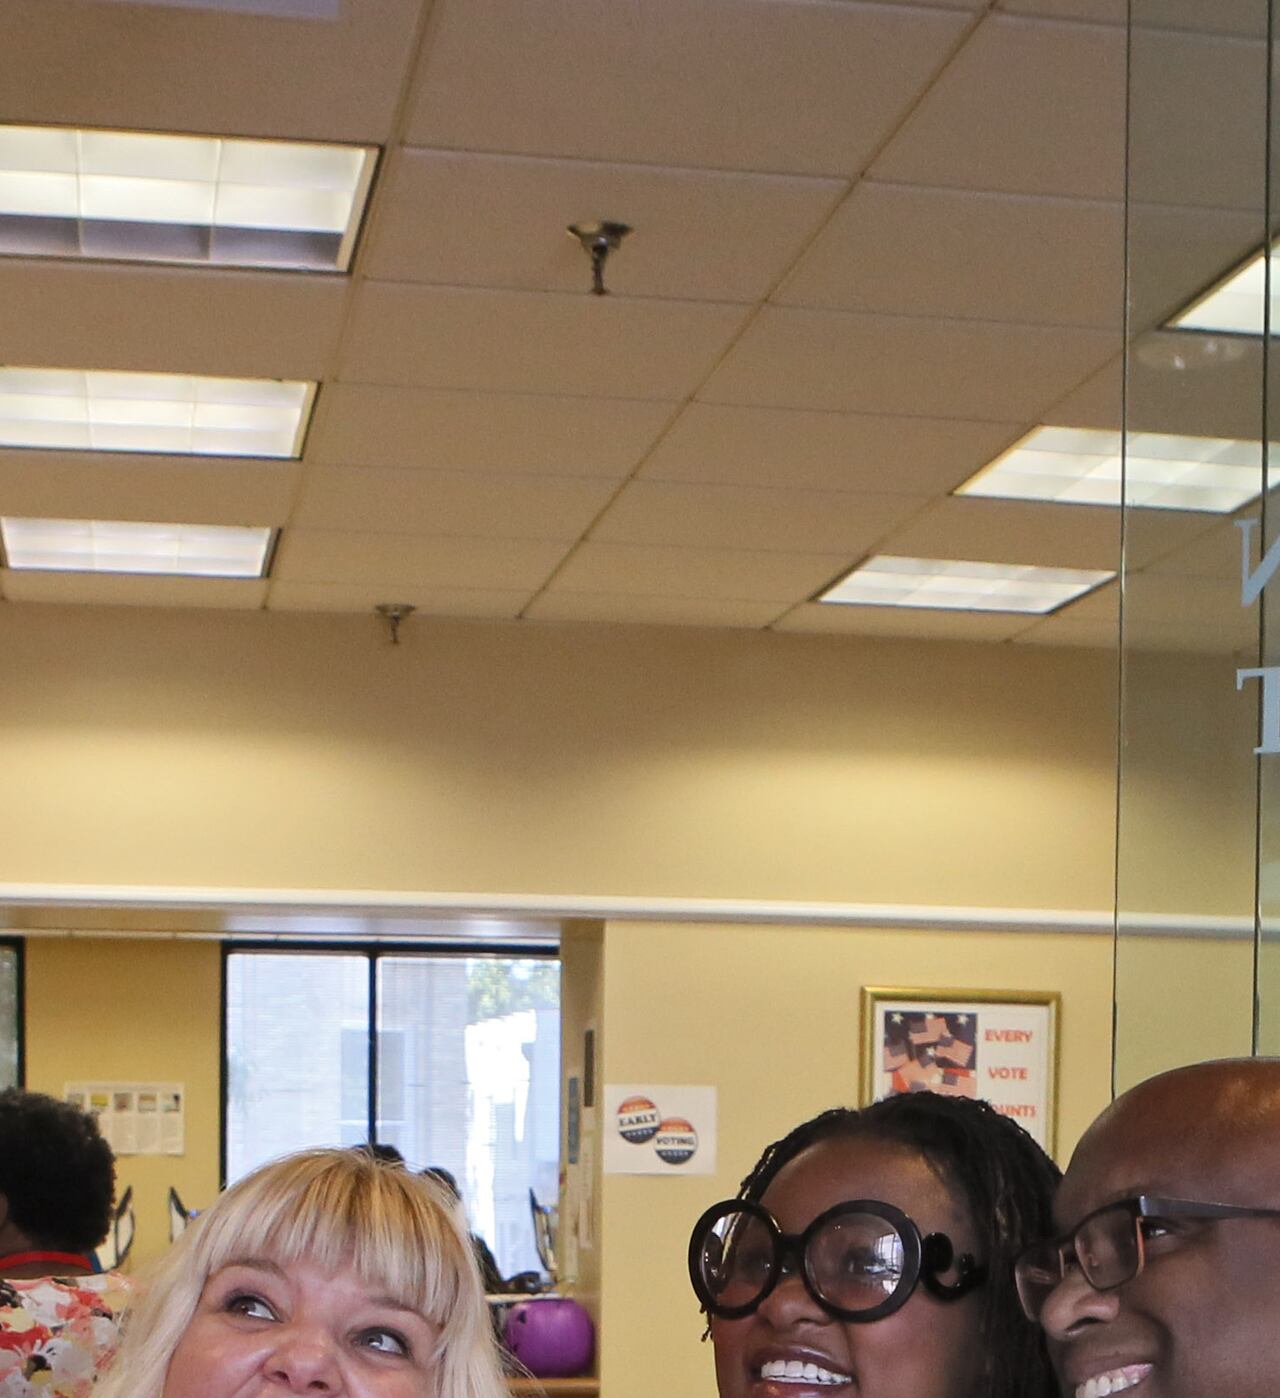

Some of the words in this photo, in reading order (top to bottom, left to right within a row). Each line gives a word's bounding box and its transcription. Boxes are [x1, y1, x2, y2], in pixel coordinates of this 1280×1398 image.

[984, 1029, 1033, 1043] EVERY
[988, 1067, 1028, 1080] VOTE
[619, 1114, 656, 1127] EARLY
[656, 1136, 695, 1145] VOTING
